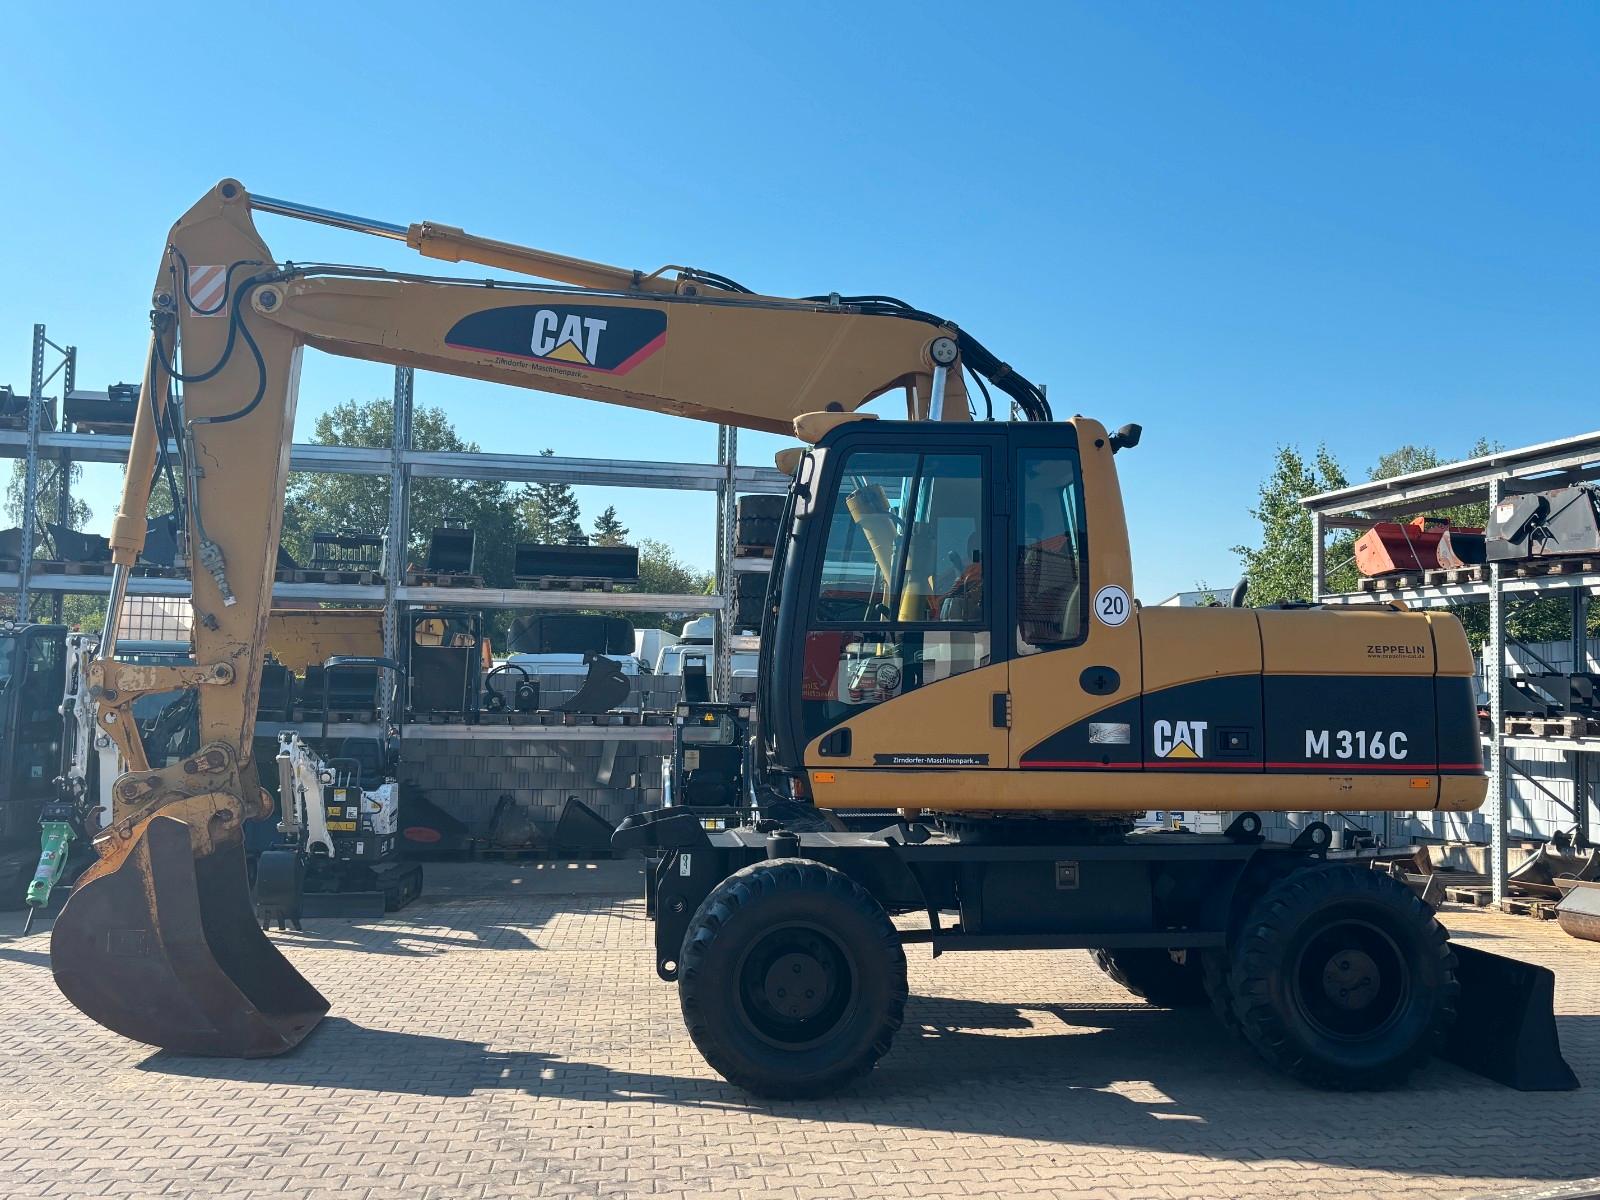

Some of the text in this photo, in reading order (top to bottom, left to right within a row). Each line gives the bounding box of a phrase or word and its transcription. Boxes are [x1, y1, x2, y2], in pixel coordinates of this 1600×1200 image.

[530, 309, 608, 366] CAT
[1102, 596, 1124, 615] 20
[1367, 645, 1425, 654] ZEPPELIN
[1153, 719, 1208, 759] CAT
[1335, 730, 1408, 760] 316C
